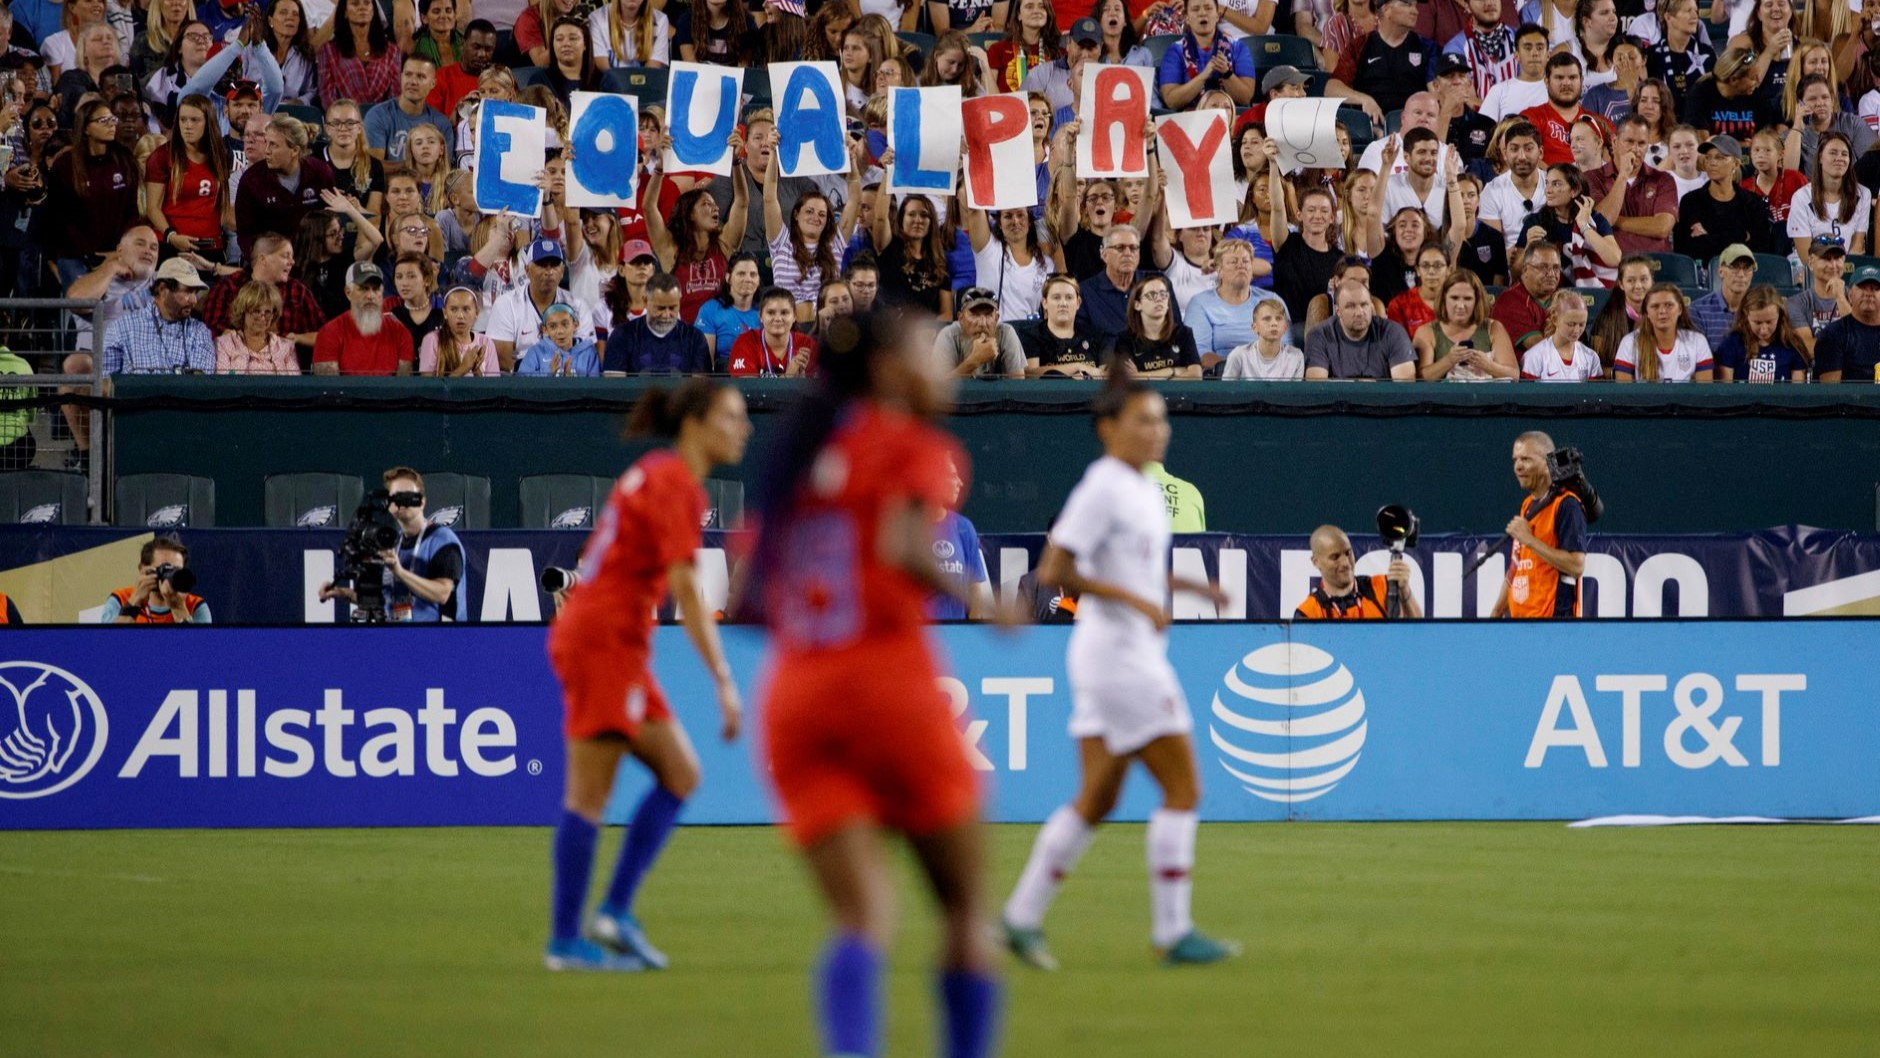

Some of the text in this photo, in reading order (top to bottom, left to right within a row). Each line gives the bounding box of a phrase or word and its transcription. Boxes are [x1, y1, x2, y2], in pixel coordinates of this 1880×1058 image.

[1712, 110, 1754, 121] AVELLE
[1057, 353, 1086, 362] WORLD
[1144, 359, 1174, 370] WORLD
[1751, 361, 1774, 374] USA
[1525, 673, 1807, 769] AT&T
[118, 688, 517, 778] Allstate
